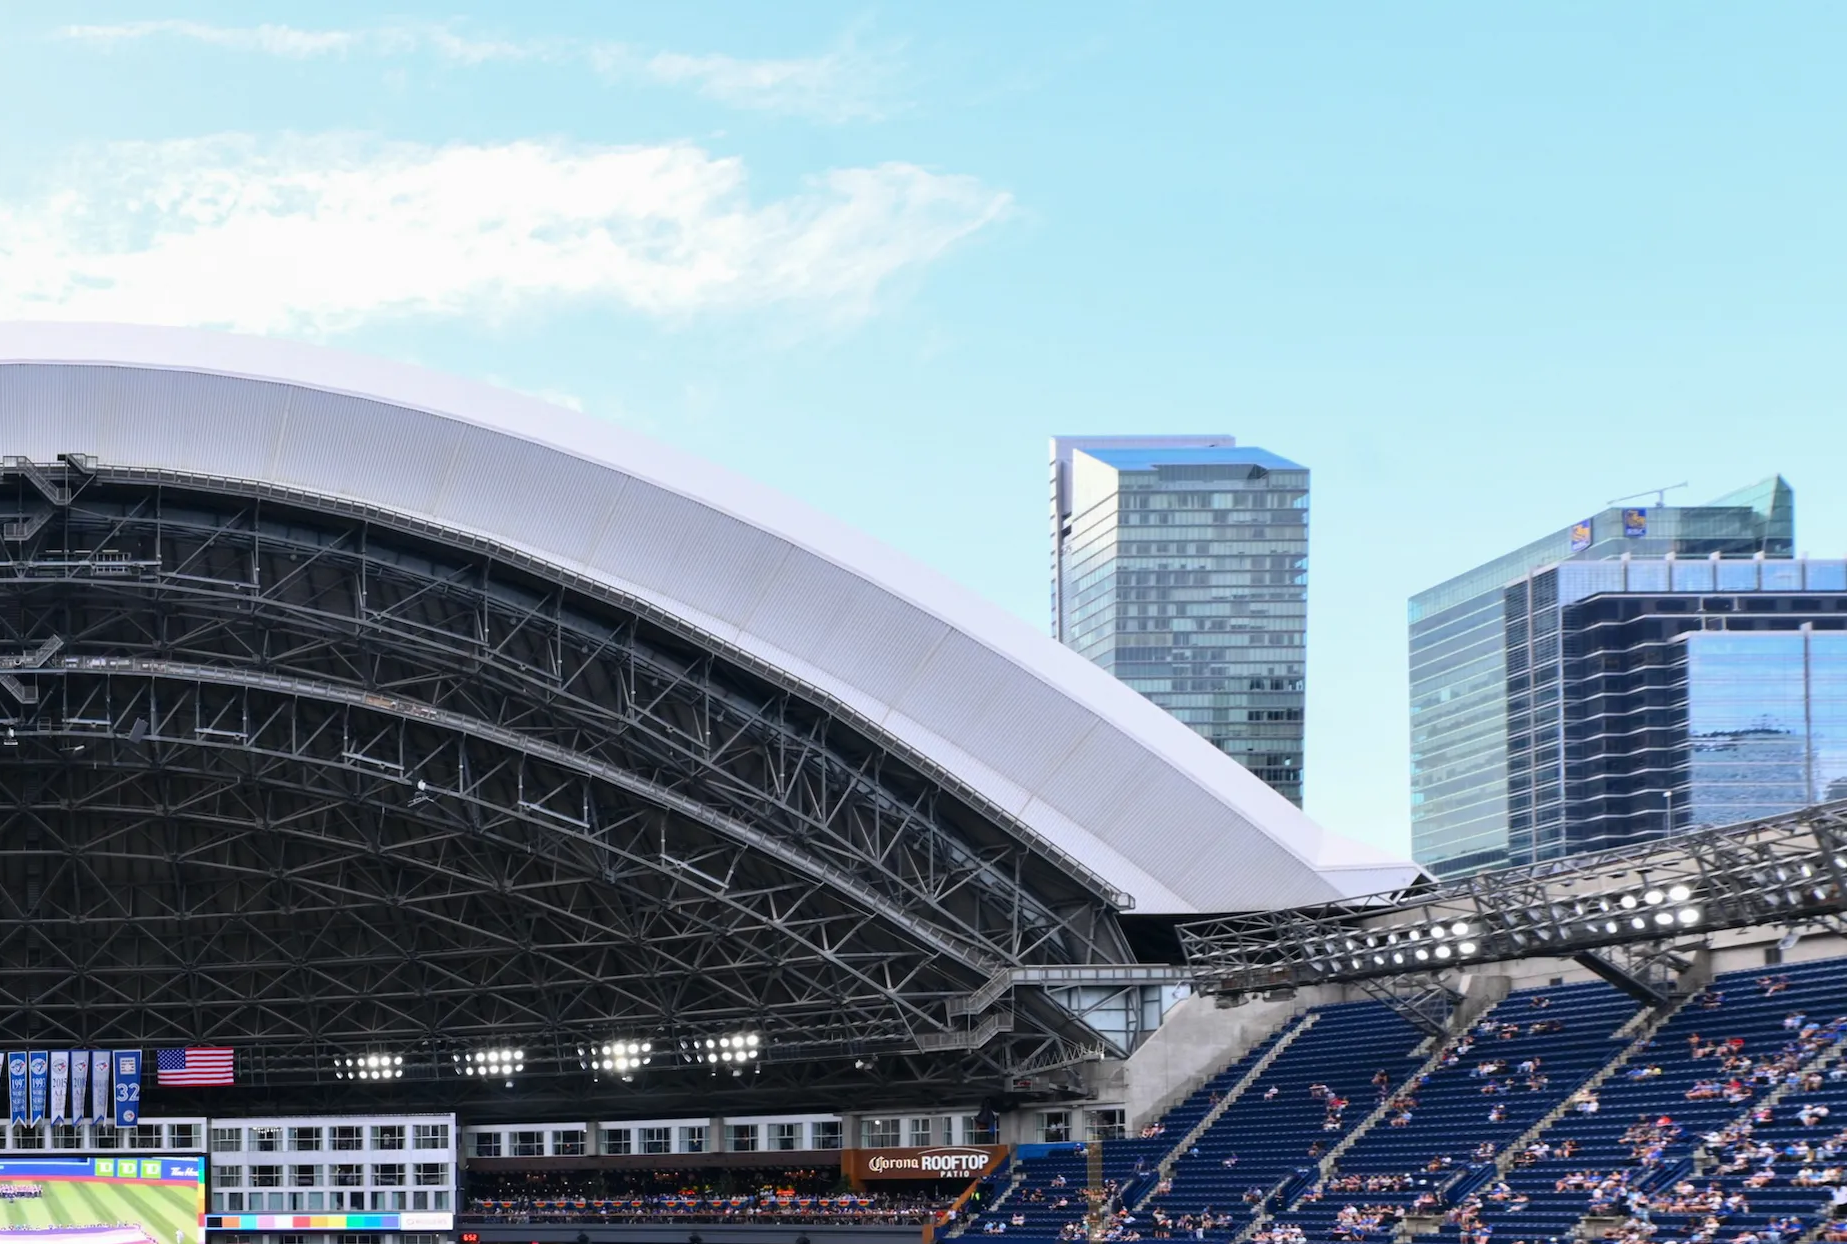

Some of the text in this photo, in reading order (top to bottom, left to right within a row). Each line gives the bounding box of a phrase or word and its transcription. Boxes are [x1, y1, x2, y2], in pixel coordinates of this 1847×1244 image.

[116, 1082, 141, 1102] 32
[869, 1154, 989, 1173] Corona ROOFTOP
[940, 1170, 970, 1178] PATIO
